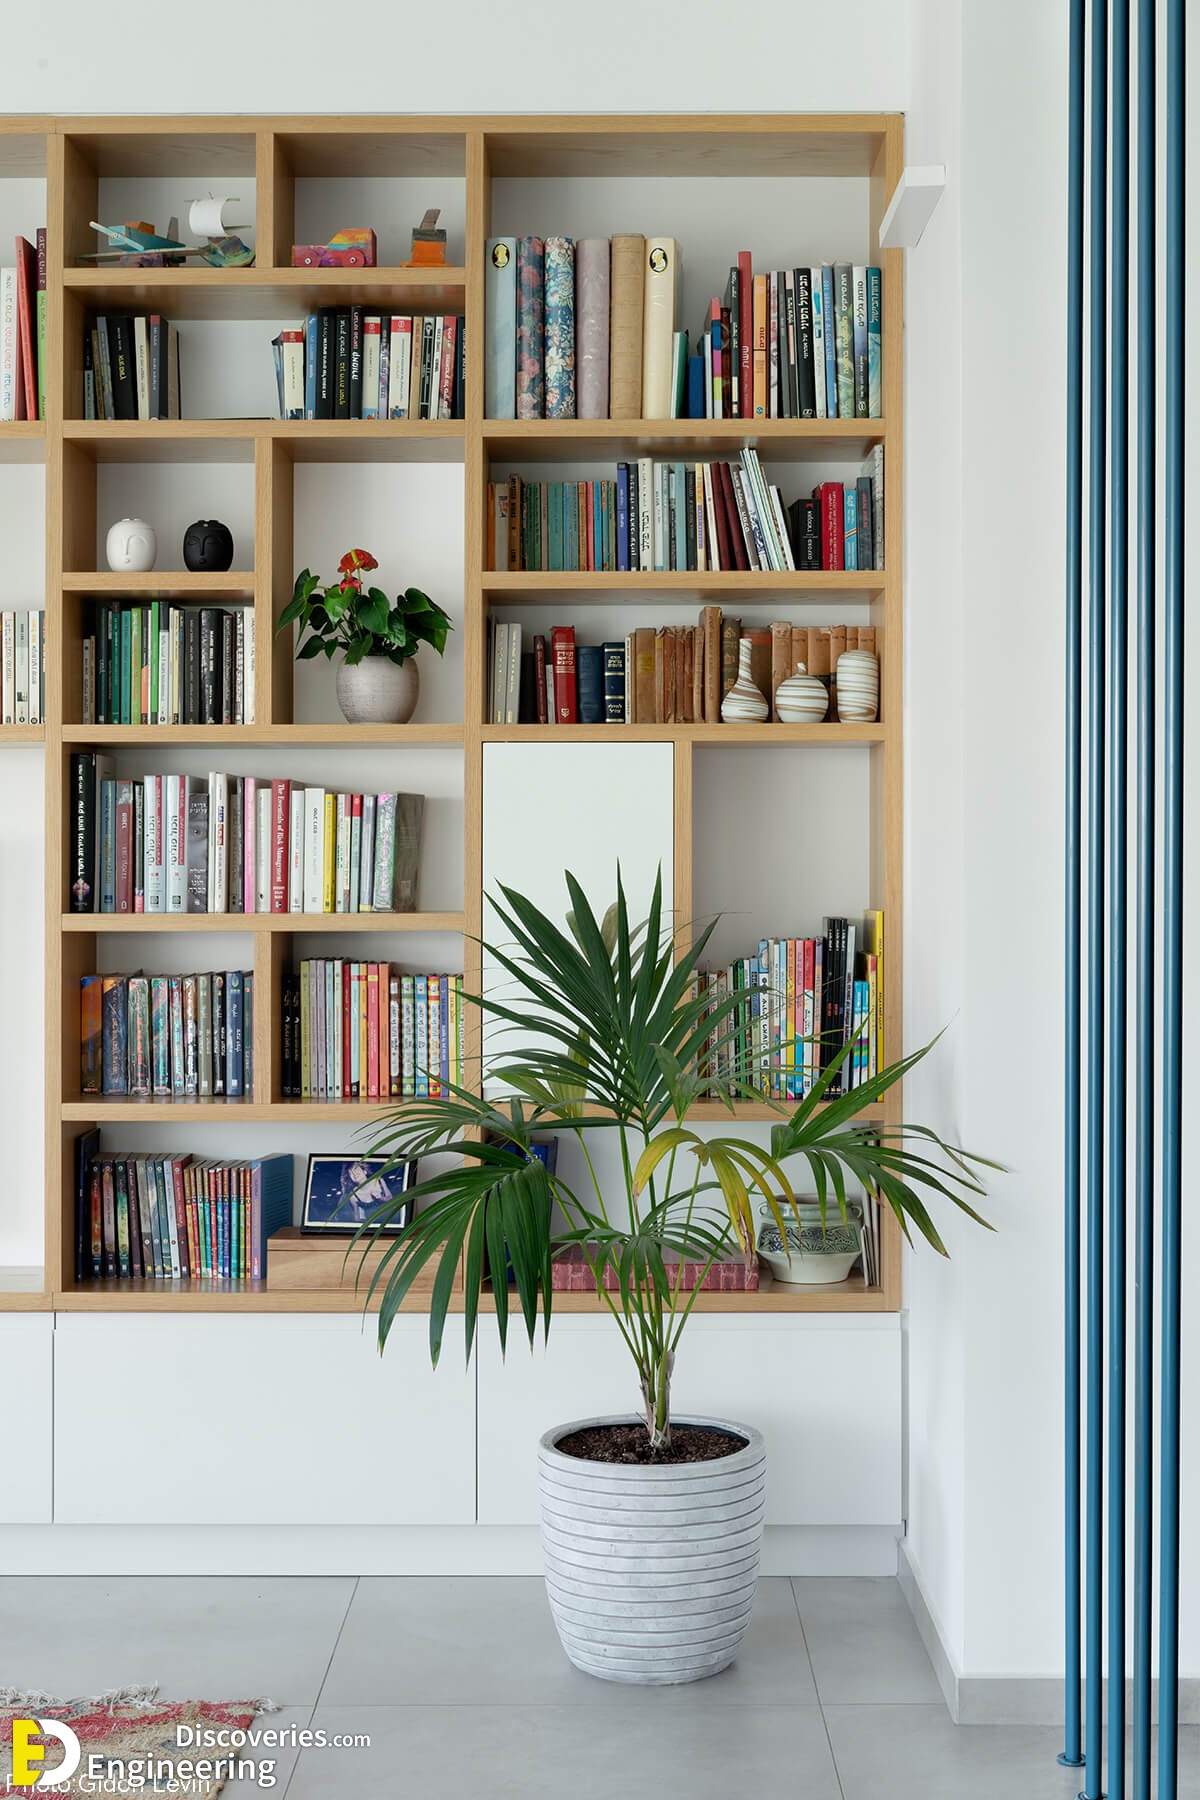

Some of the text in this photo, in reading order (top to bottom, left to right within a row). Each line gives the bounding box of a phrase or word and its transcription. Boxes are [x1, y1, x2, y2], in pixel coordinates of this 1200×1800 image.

[798, 275, 808, 306] הבישול
[800, 307, 809, 330] הסיני
[277, 783, 285, 795] The
[276, 795, 285, 824] Essentials
[276, 832, 285, 845] Risk
[274, 846, 285, 883] Management
